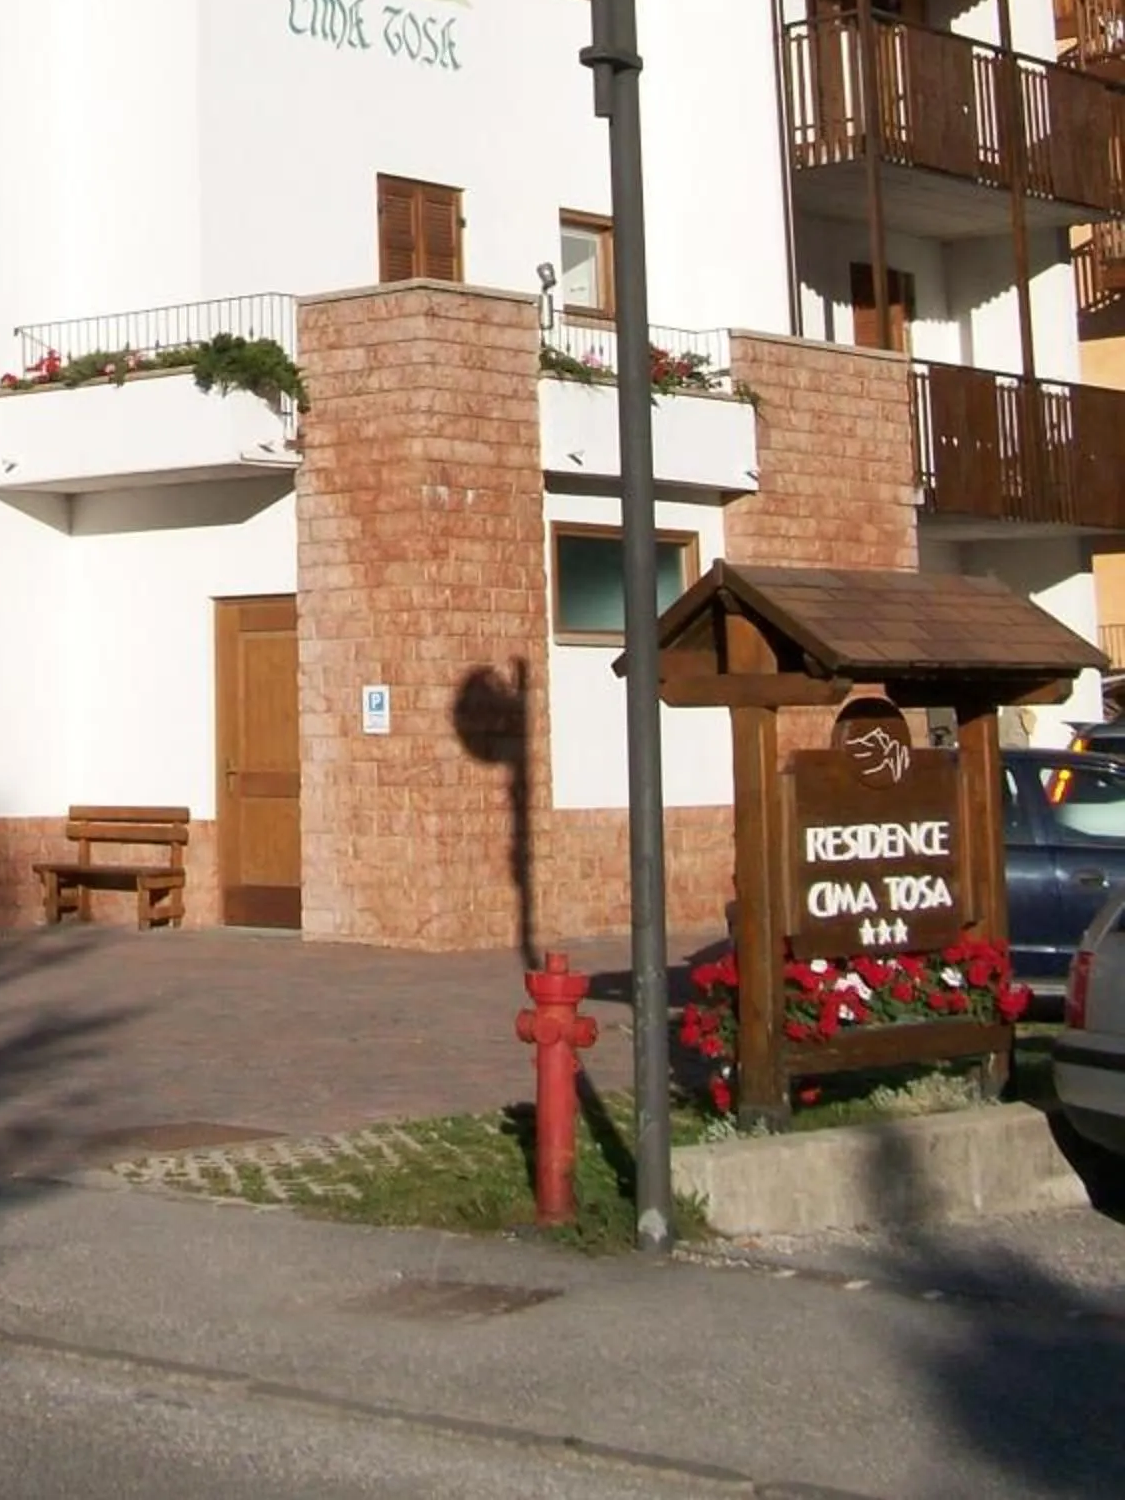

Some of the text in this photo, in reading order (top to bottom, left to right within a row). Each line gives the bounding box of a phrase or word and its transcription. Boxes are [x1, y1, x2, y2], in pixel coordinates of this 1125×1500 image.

[370, 693, 381, 709] P
[806, 821, 950, 862] RESIDENCE
[807, 875, 953, 917] CIMA TOSA
